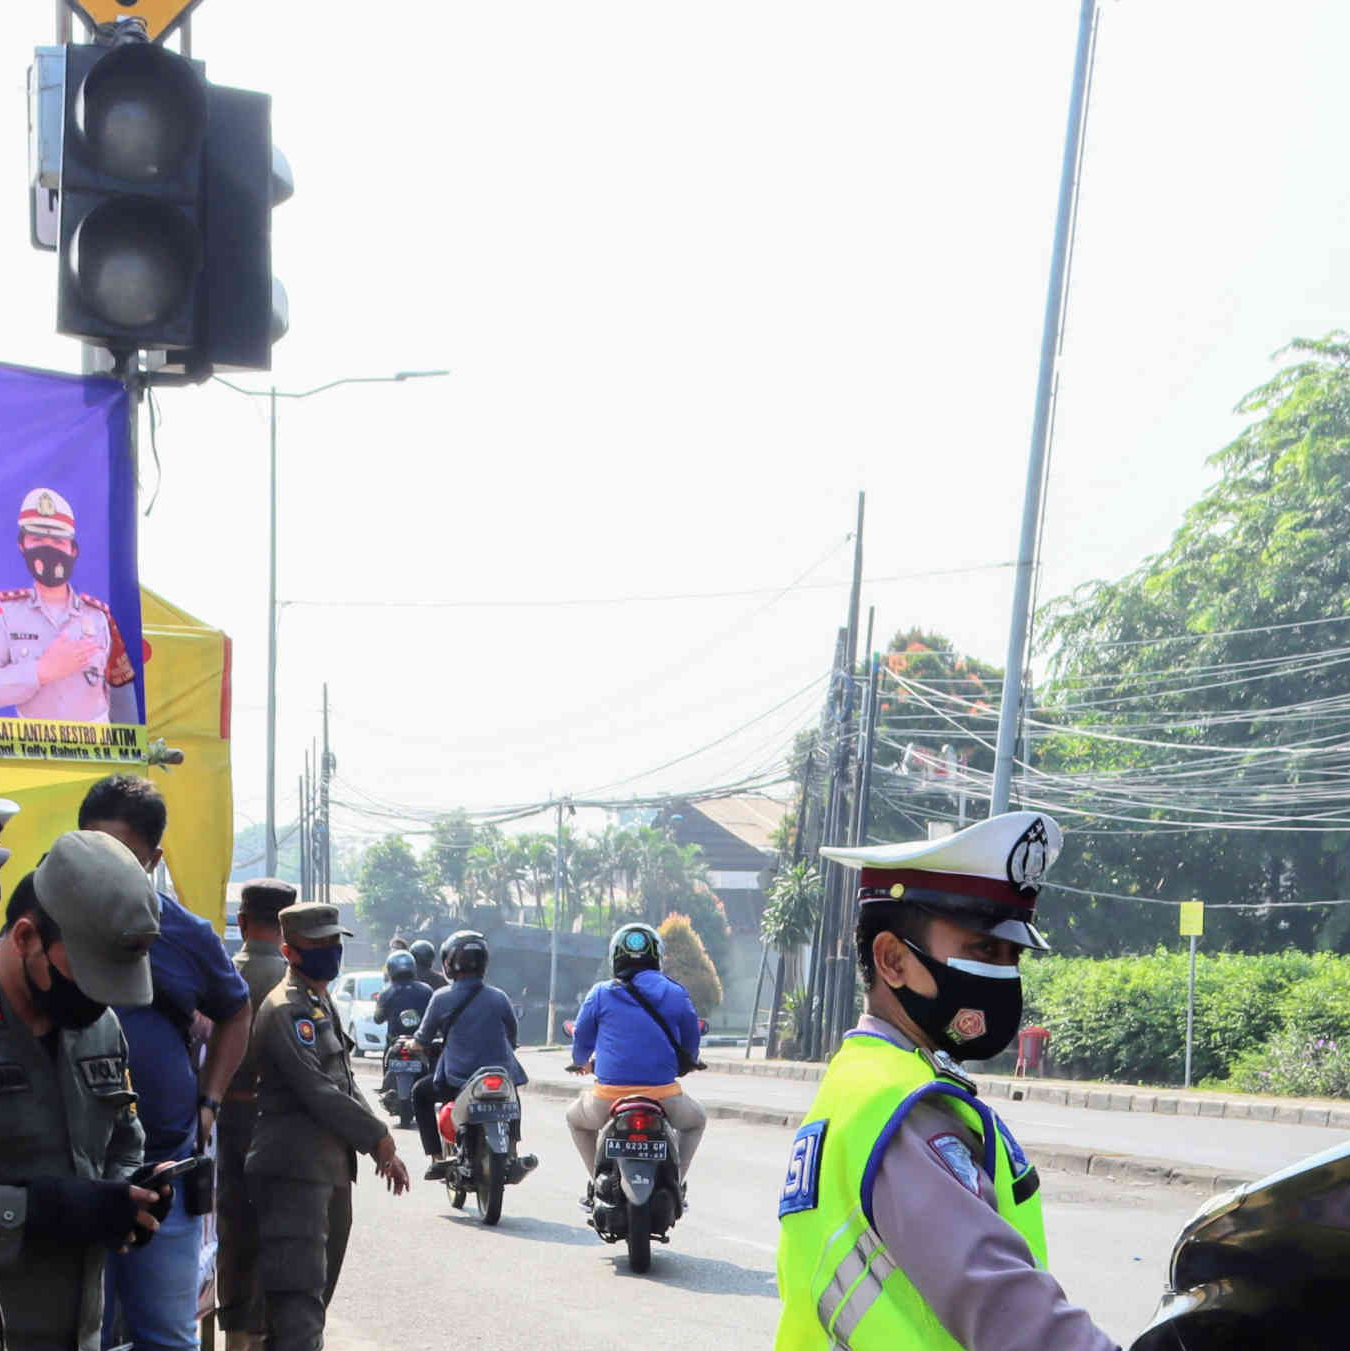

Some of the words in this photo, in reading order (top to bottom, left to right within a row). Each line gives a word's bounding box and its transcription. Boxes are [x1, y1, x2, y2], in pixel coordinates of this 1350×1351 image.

[17, 721, 57, 743] LANTAS
[60, 725, 96, 745] RESTRO
[99, 727, 138, 747] JAKTIM
[781, 1135, 816, 1197] SI
